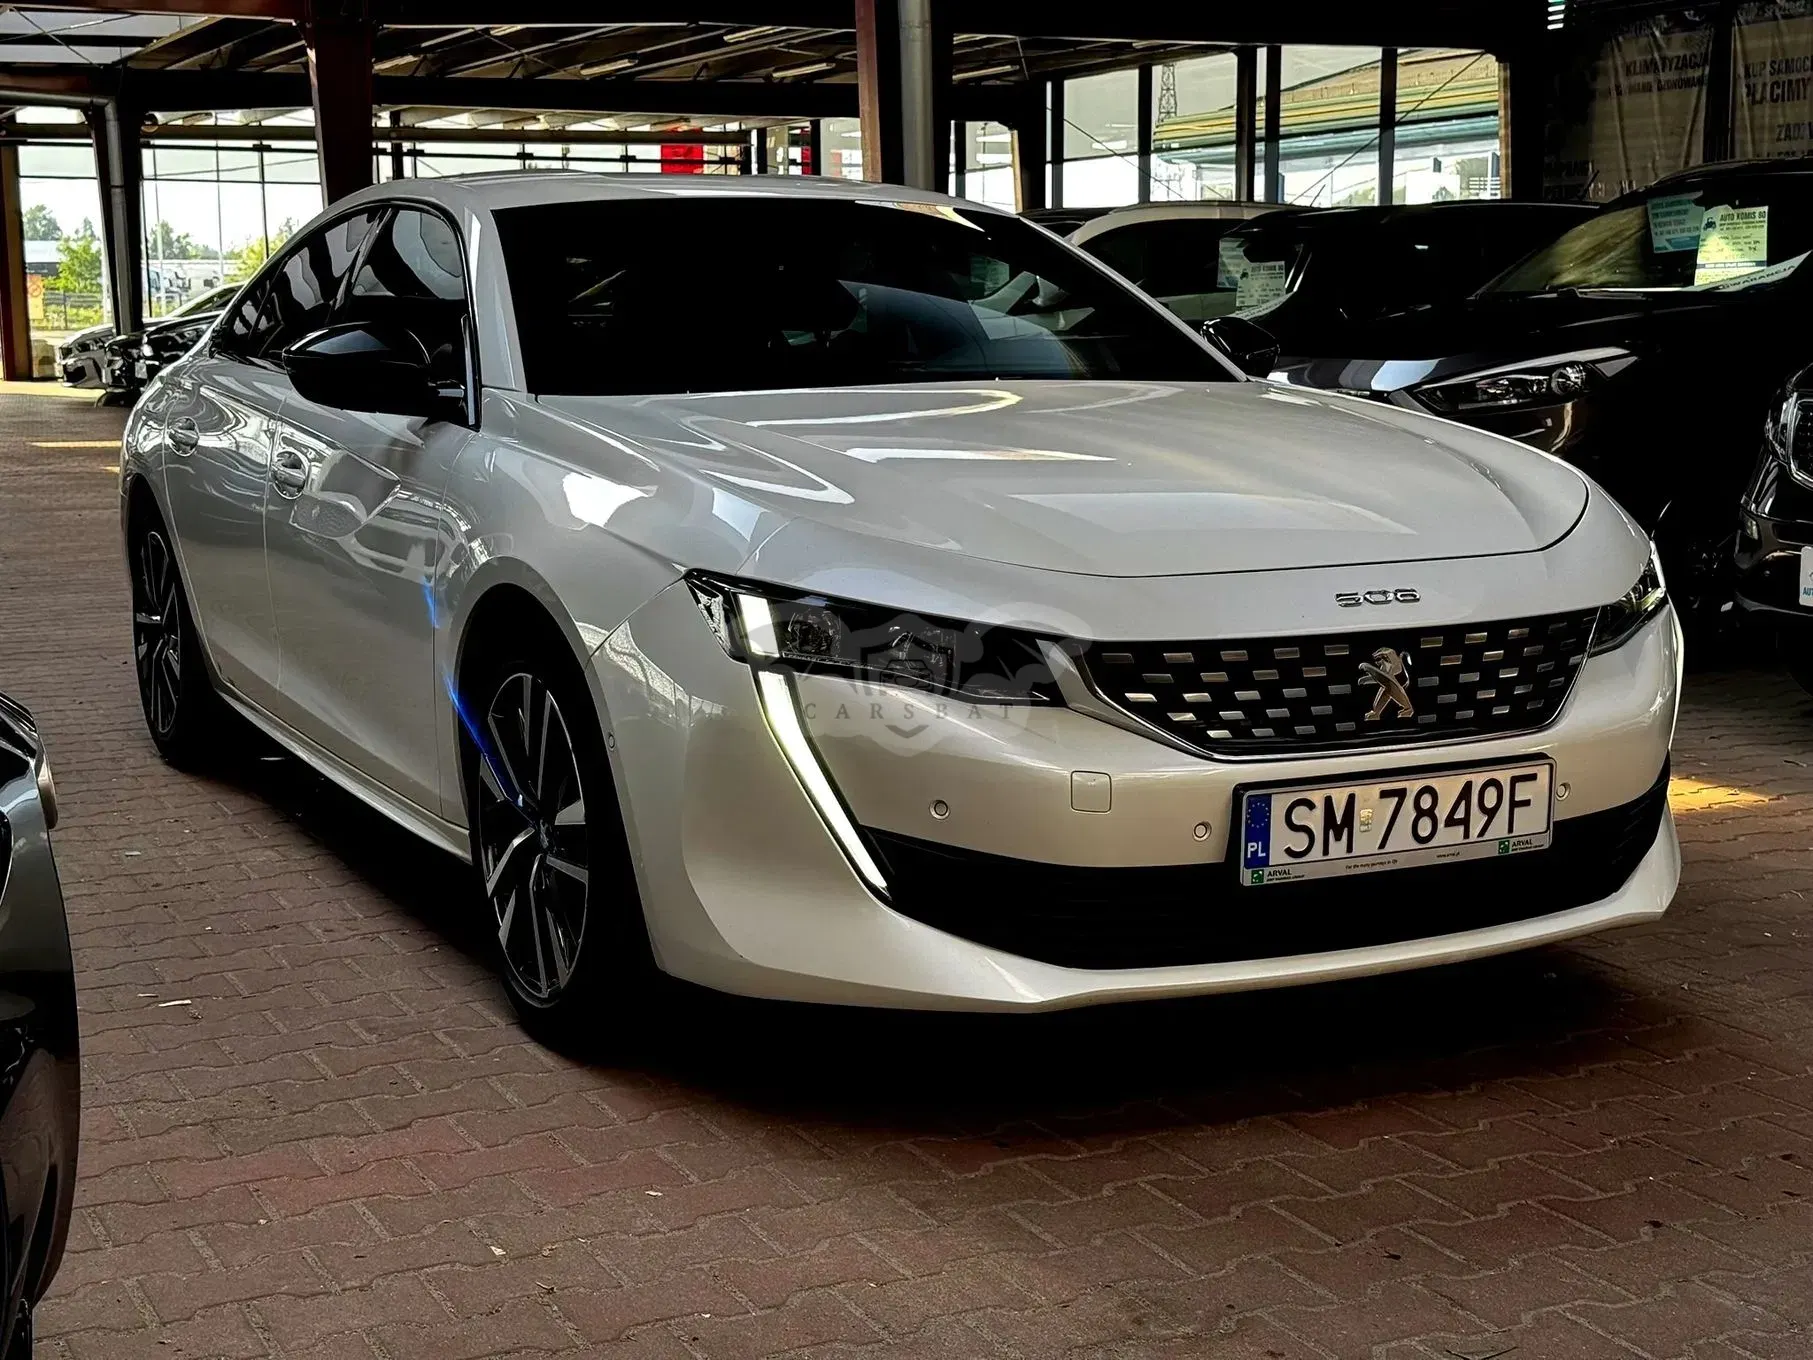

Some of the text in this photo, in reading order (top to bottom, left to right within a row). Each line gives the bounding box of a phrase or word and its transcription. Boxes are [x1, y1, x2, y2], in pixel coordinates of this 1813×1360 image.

[1335, 588, 1421, 607] 508
[1284, 773, 1538, 859] SM 7849F
[1247, 841, 1267, 859] PL
[1511, 839, 1532, 847] ARVAL
[1267, 869, 1292, 877] ARVAL
